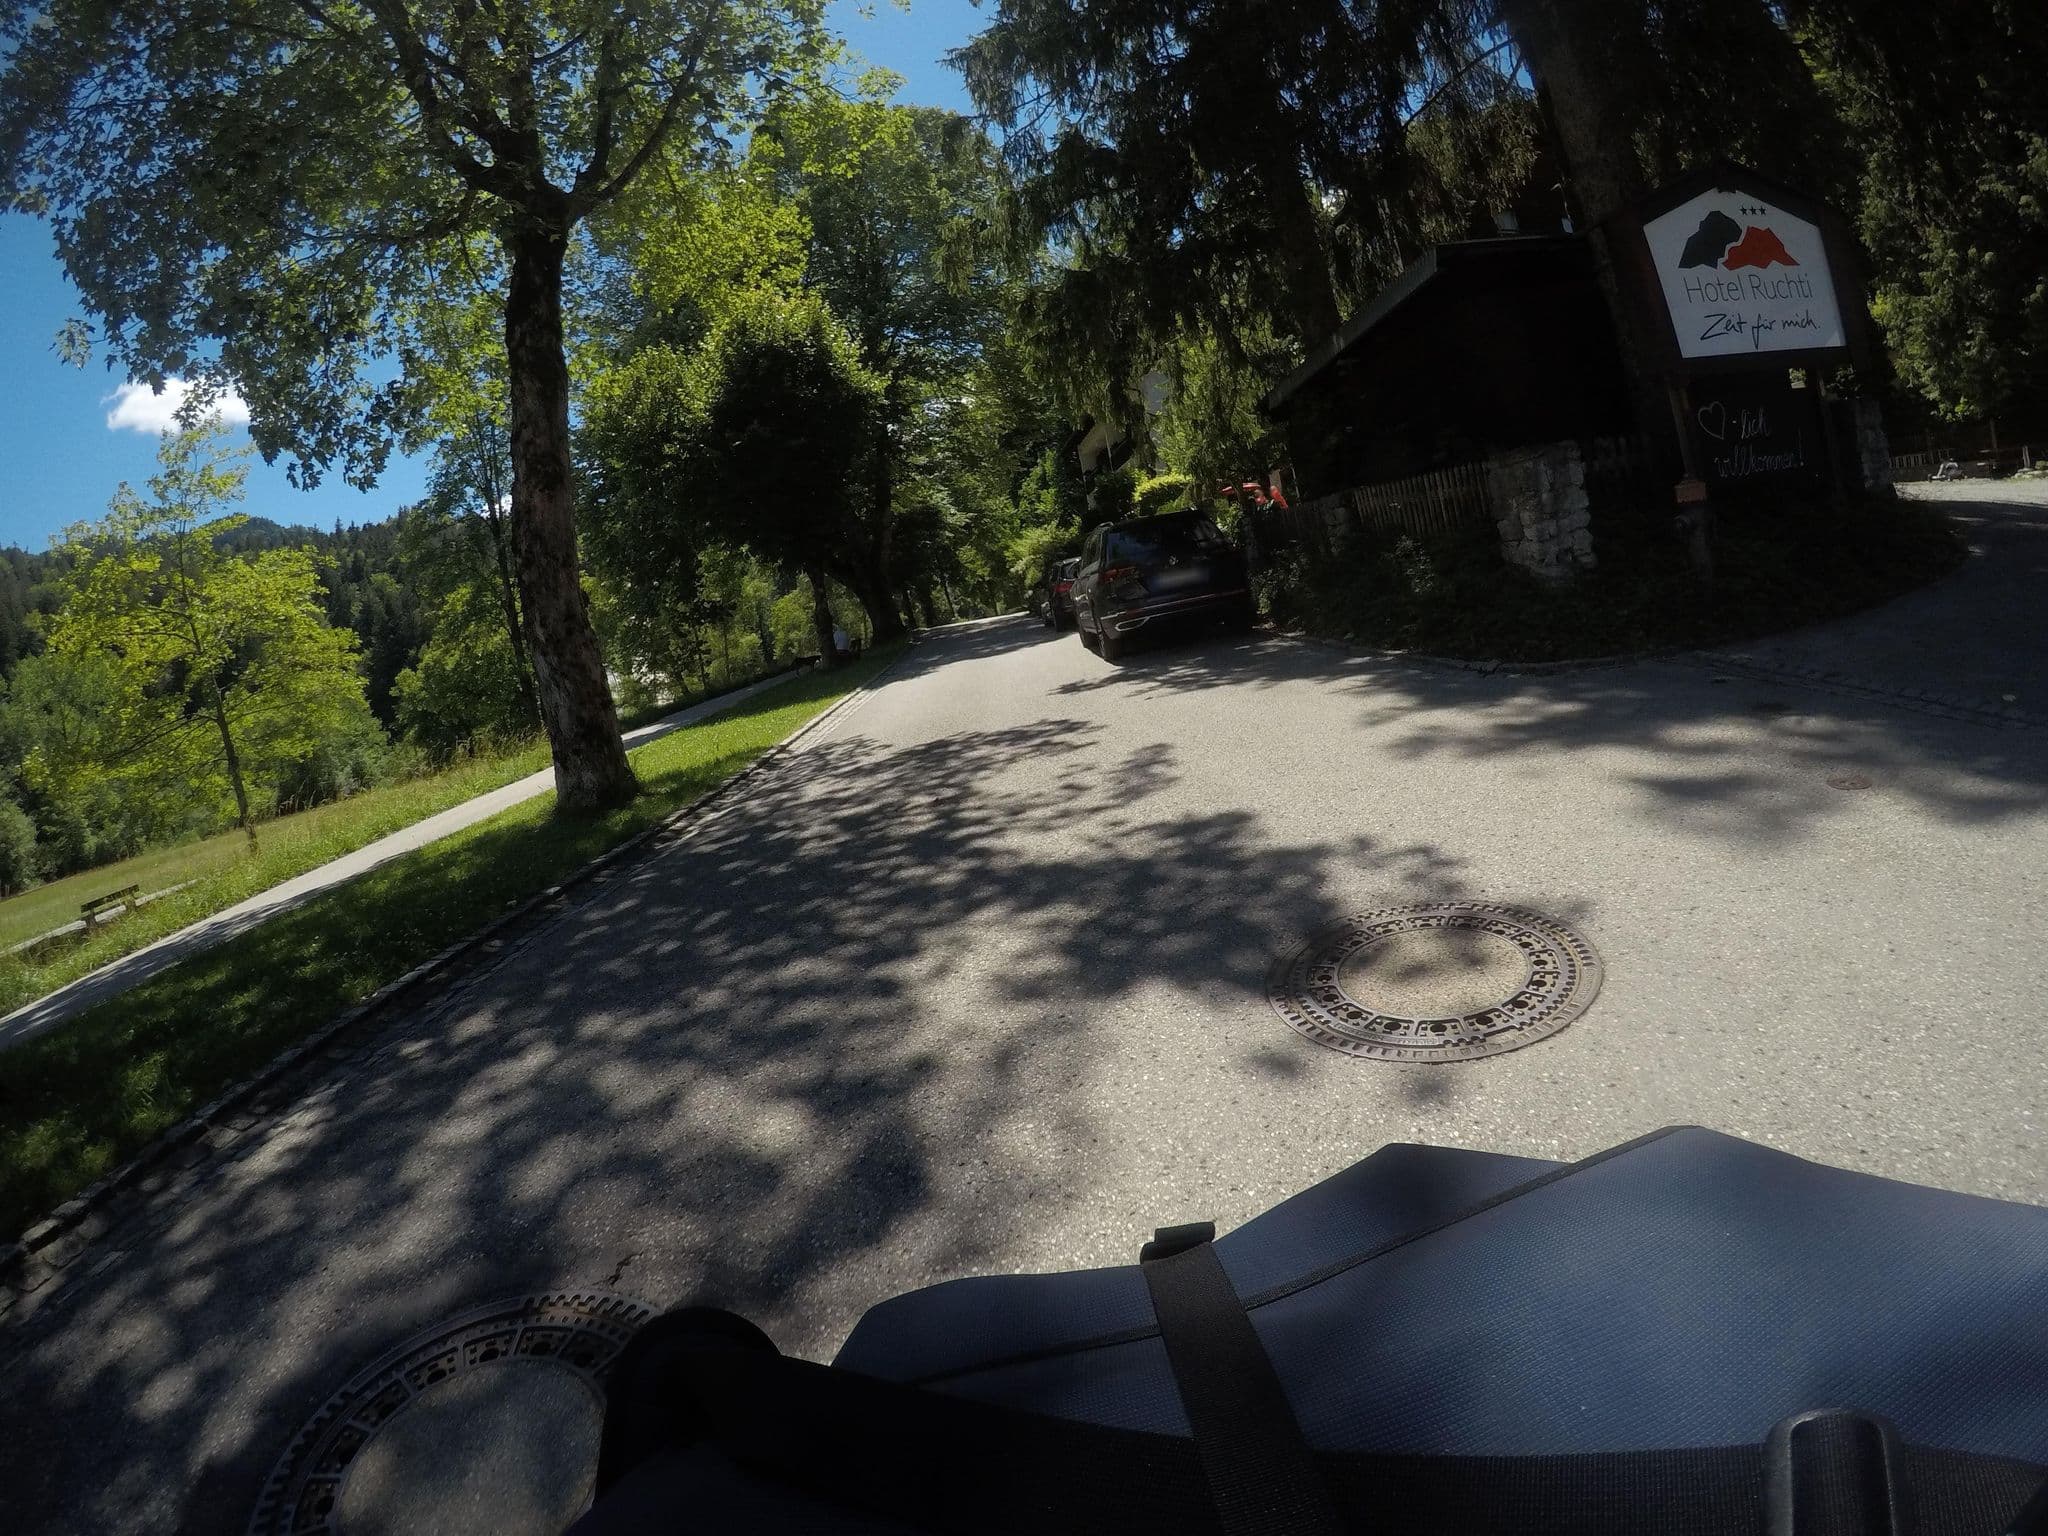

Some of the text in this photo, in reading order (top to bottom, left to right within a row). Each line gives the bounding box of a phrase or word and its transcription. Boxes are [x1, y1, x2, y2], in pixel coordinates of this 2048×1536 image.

[1683, 273, 1813, 303] Hotel Ruchti
[1700, 313, 1747, 340] Zeit
